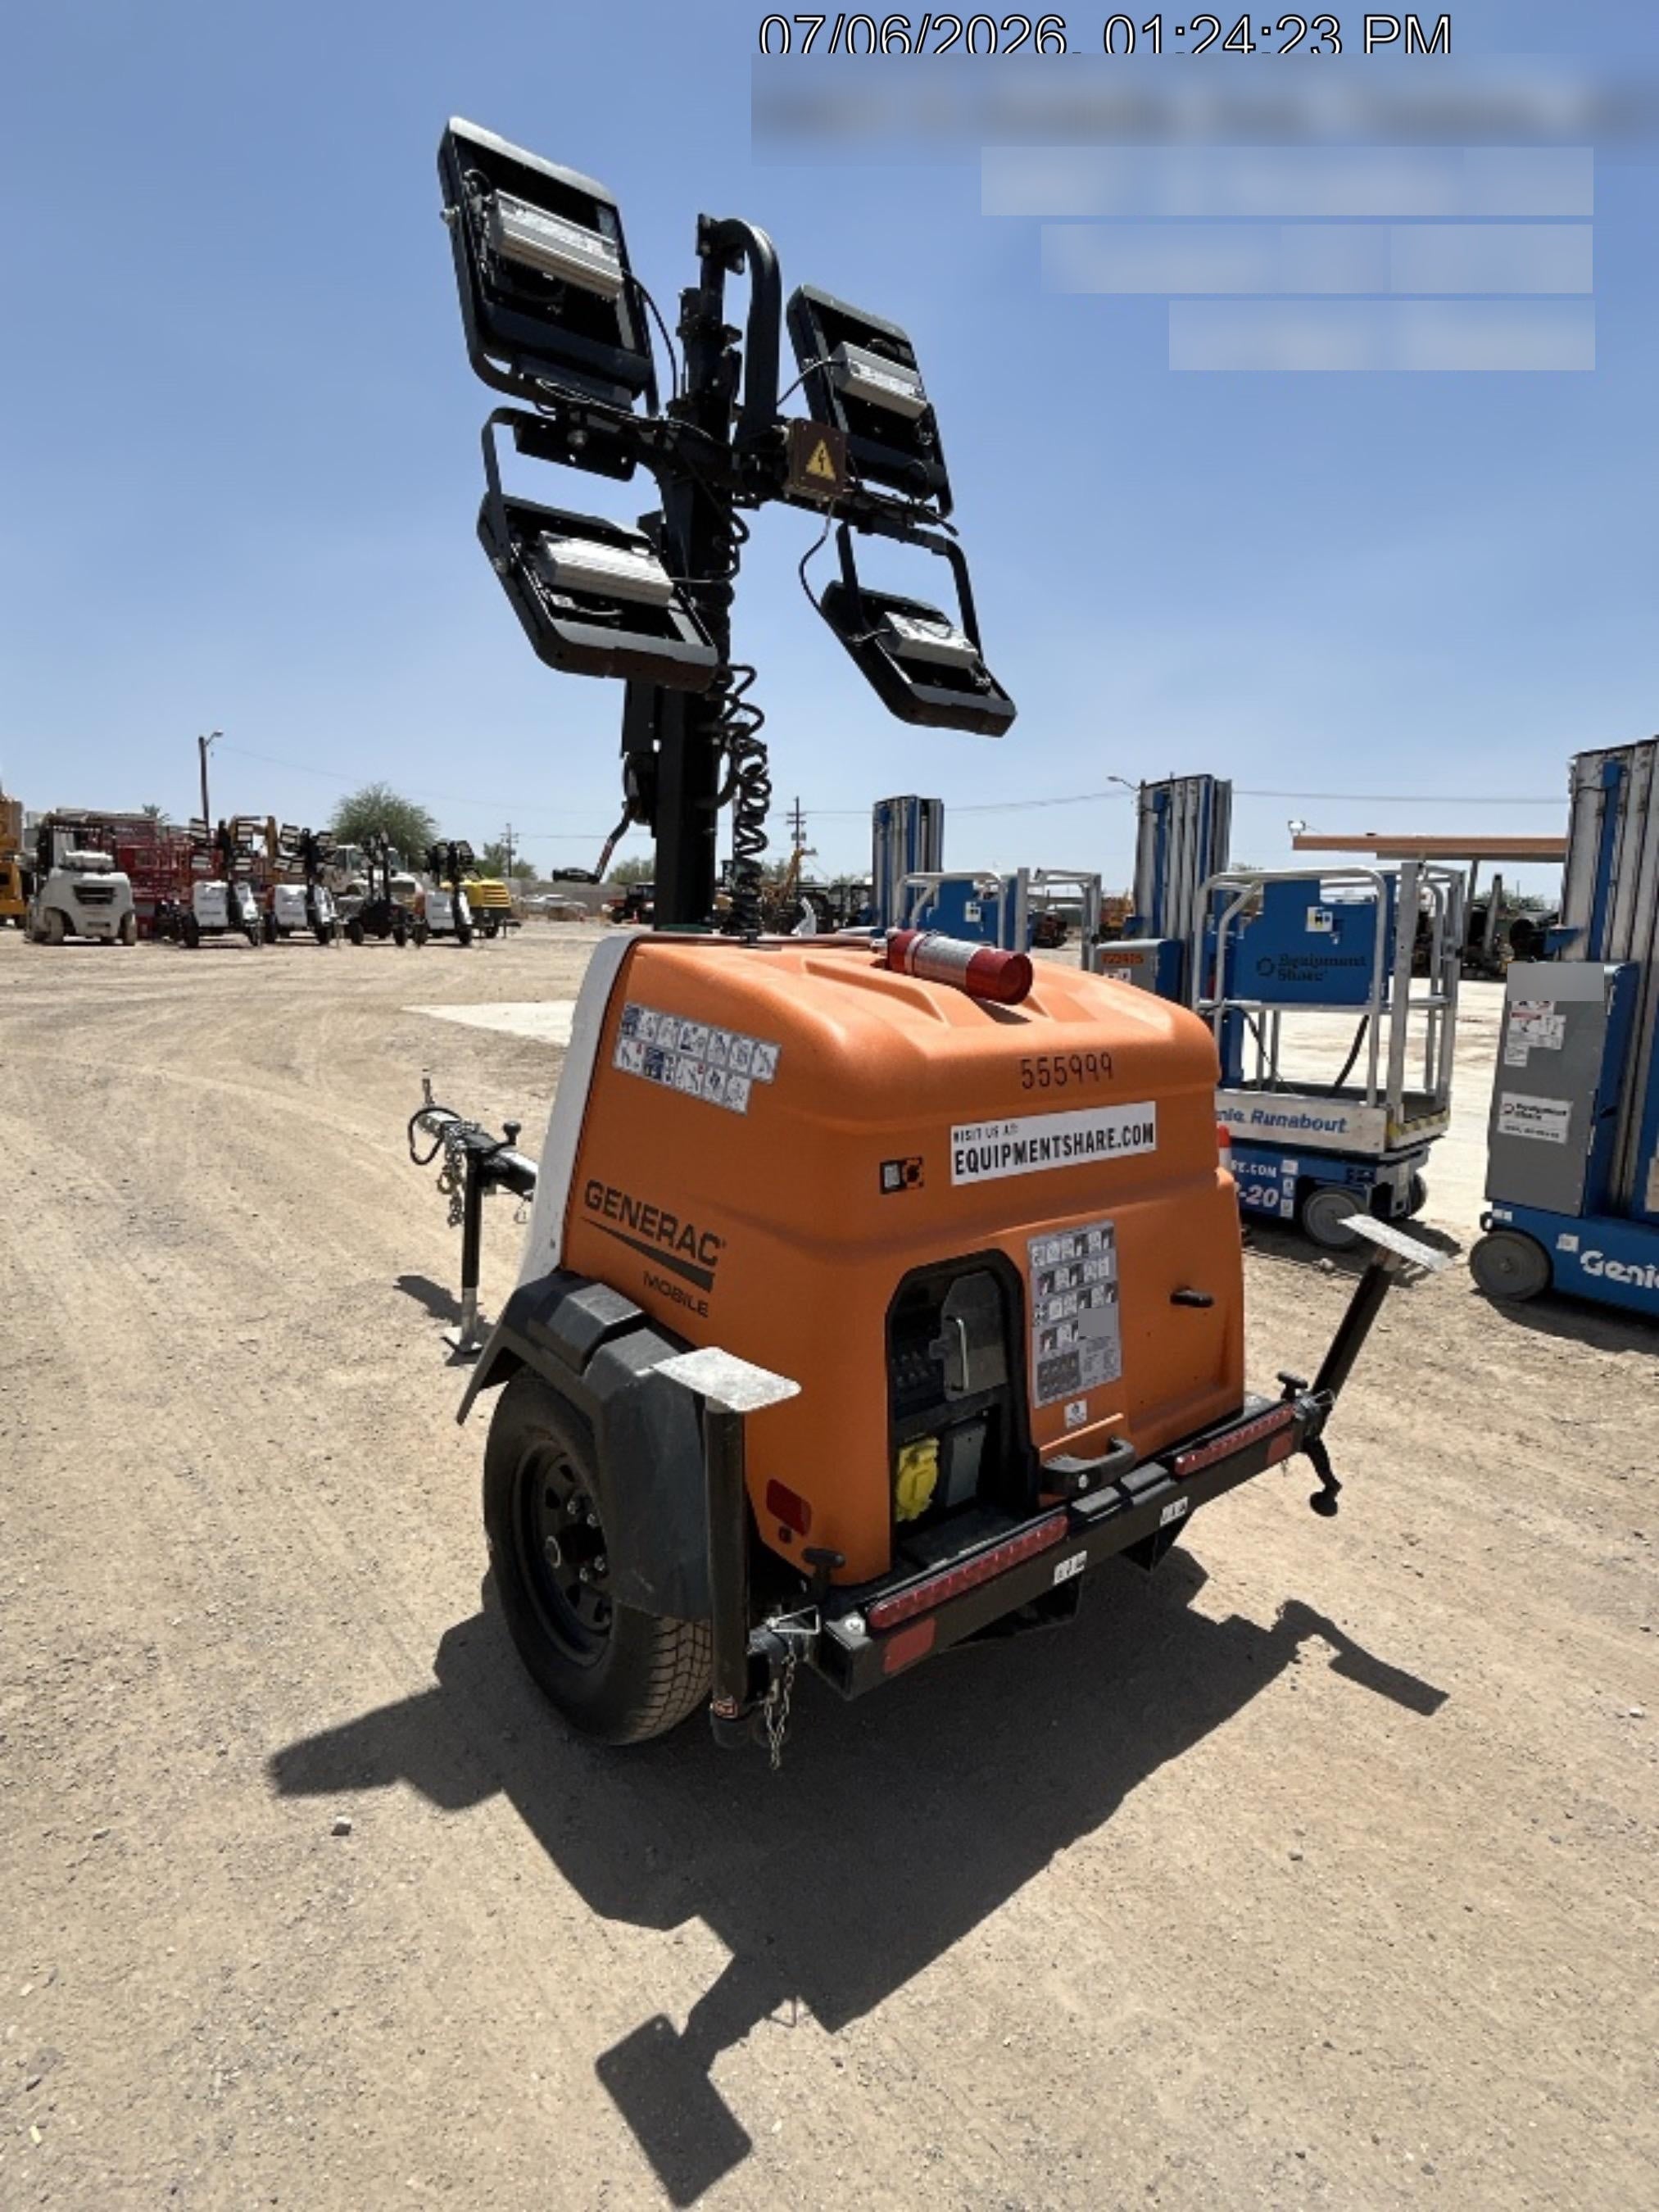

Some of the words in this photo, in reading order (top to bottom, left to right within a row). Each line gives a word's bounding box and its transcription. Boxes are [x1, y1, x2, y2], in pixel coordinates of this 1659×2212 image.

[1021, 1052, 1113, 1090] 555999
[1216, 1108, 1244, 1122] nie
[1250, 1108, 1348, 1133] Runabout
[954, 1122, 1154, 1176] EQUIPMENTSHARE.COM
[584, 1178, 722, 1267] GENERAC
[1580, 1249, 1659, 1290] Geni
[643, 1271, 709, 1318] MOBILE
